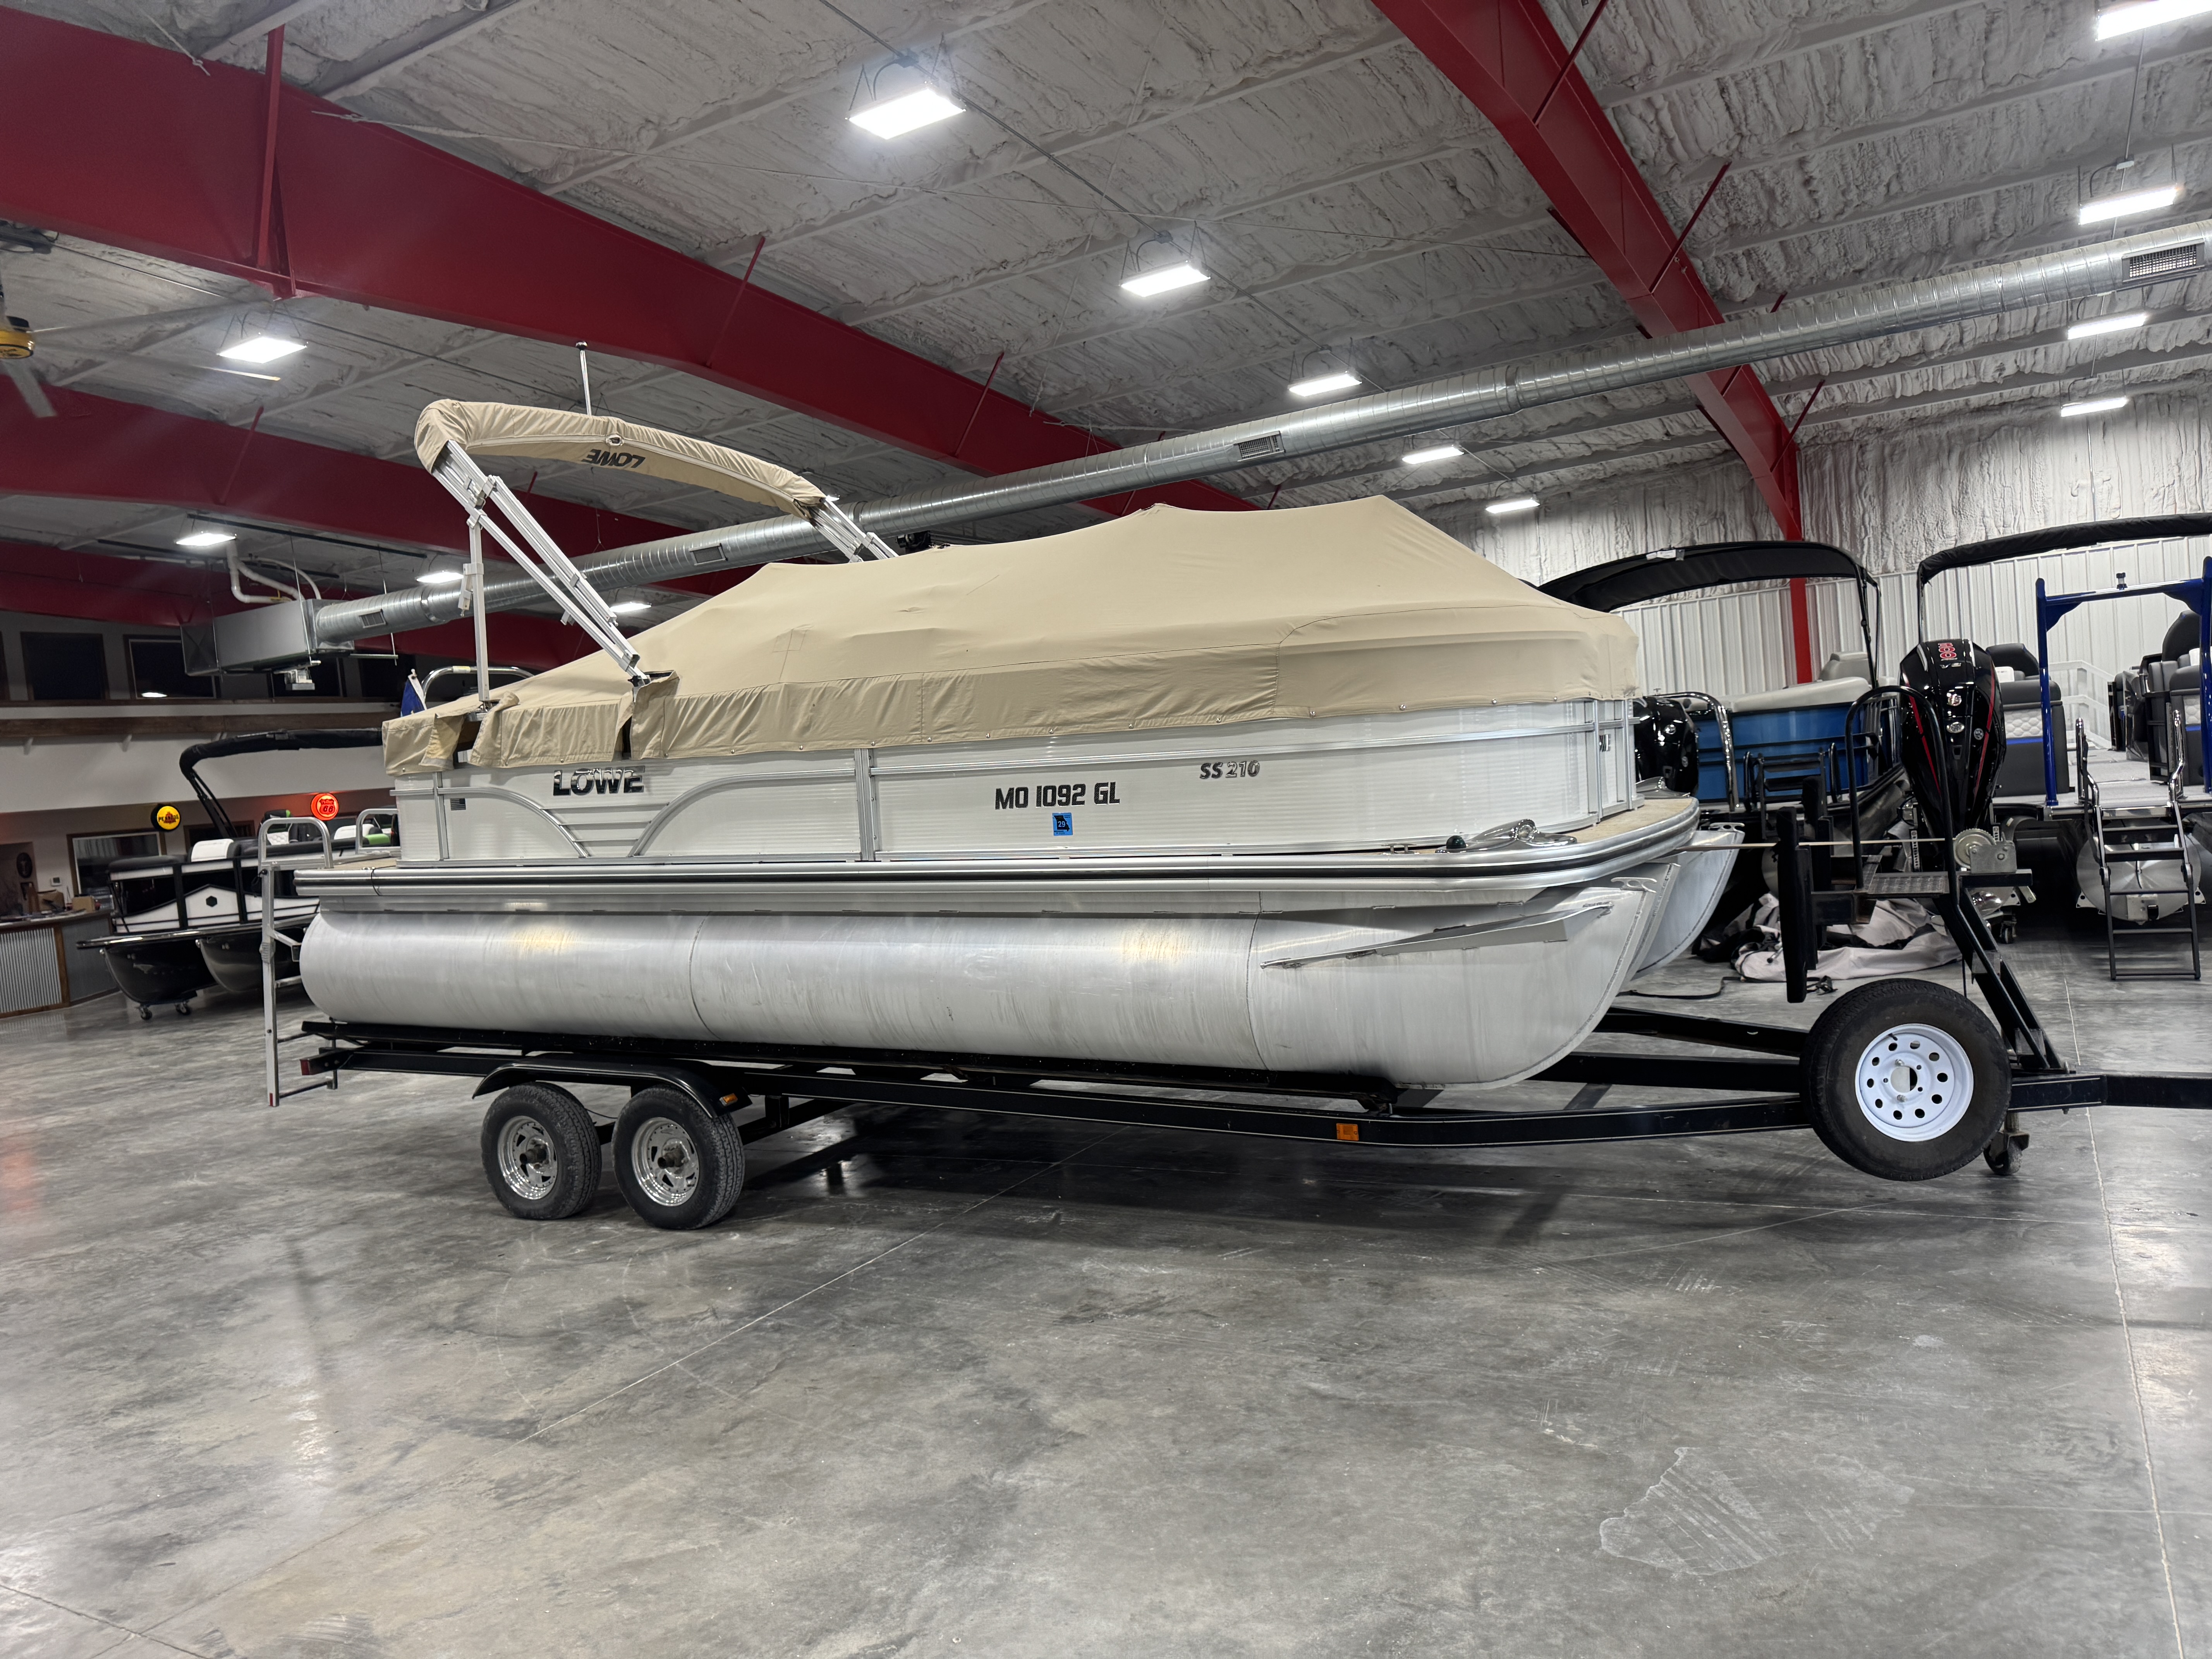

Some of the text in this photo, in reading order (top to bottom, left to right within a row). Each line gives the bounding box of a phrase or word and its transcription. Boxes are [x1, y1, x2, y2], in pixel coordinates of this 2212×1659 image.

[581, 449, 646, 468] LOWE
[553, 765, 646, 796] LOWE
[1199, 760, 1260, 779] SS 210
[995, 781, 1120, 810] MO 1092 GL
